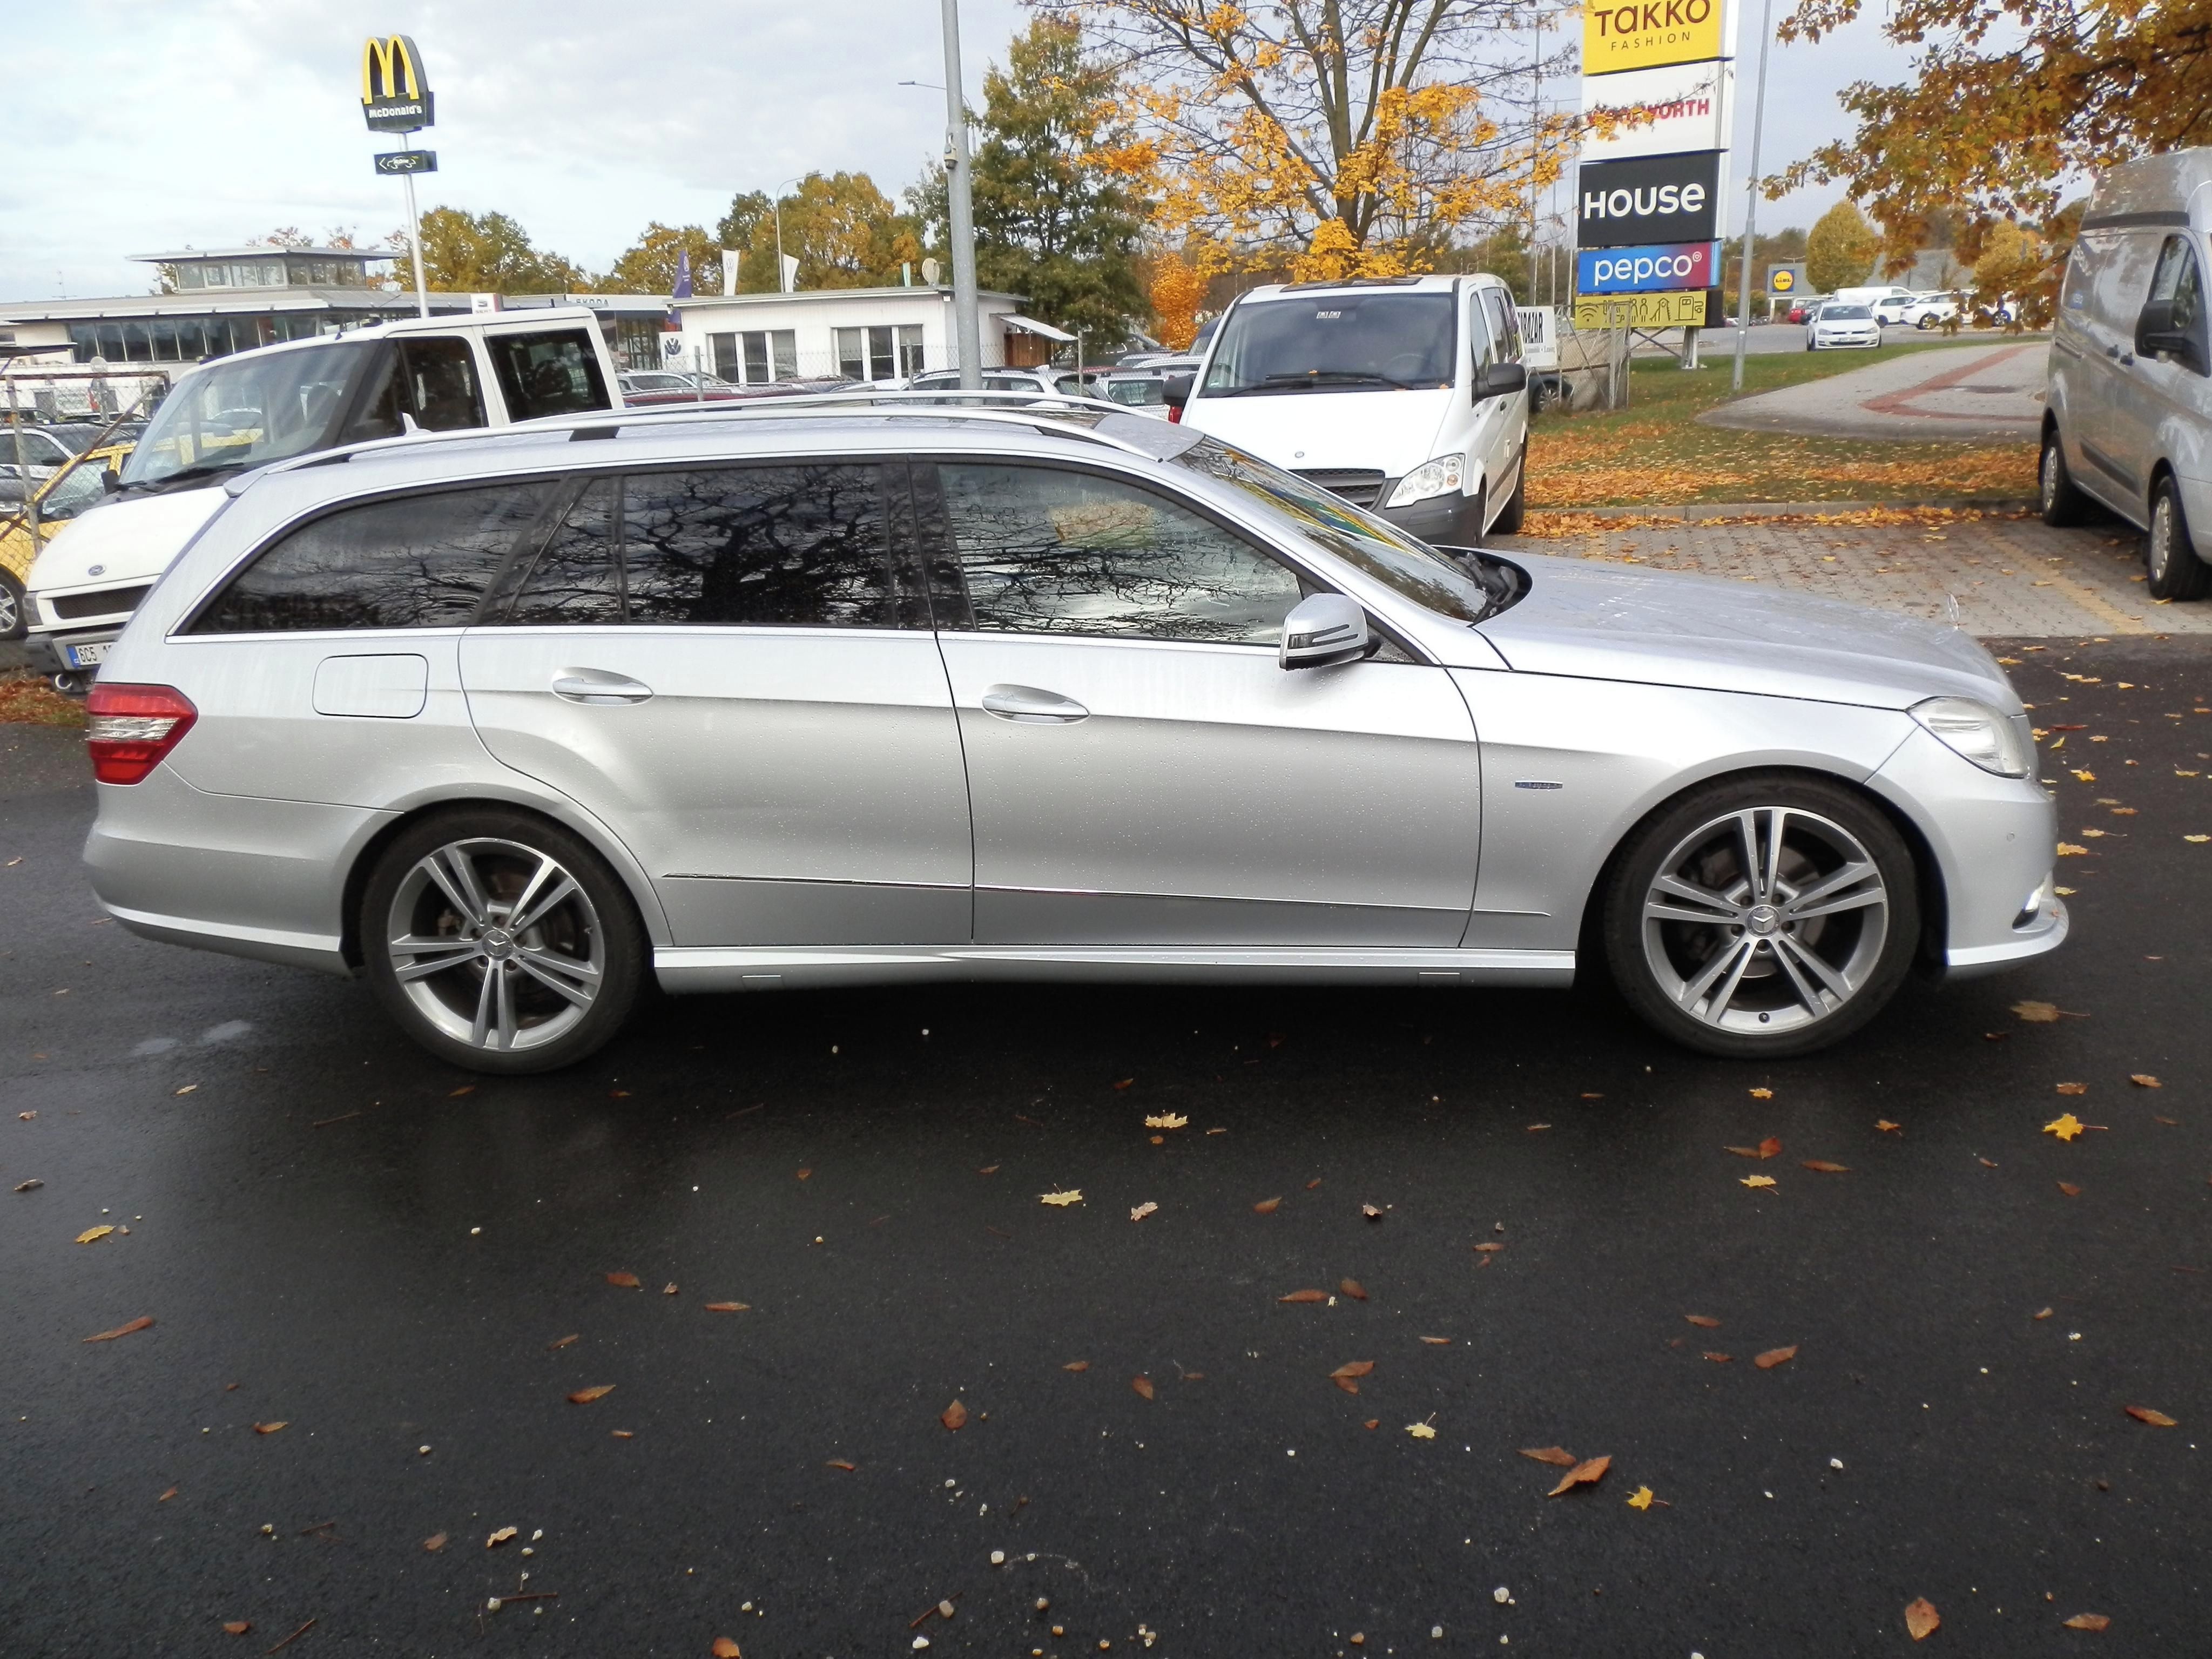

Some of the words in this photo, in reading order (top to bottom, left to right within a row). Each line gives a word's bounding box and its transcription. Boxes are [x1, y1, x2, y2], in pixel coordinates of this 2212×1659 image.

[1611, 31, 1691, 51] FASHION
[369, 105, 422, 118] McDonald's
[1594, 255, 1692, 286] pepco
[79, 647, 97, 662] 6C5
